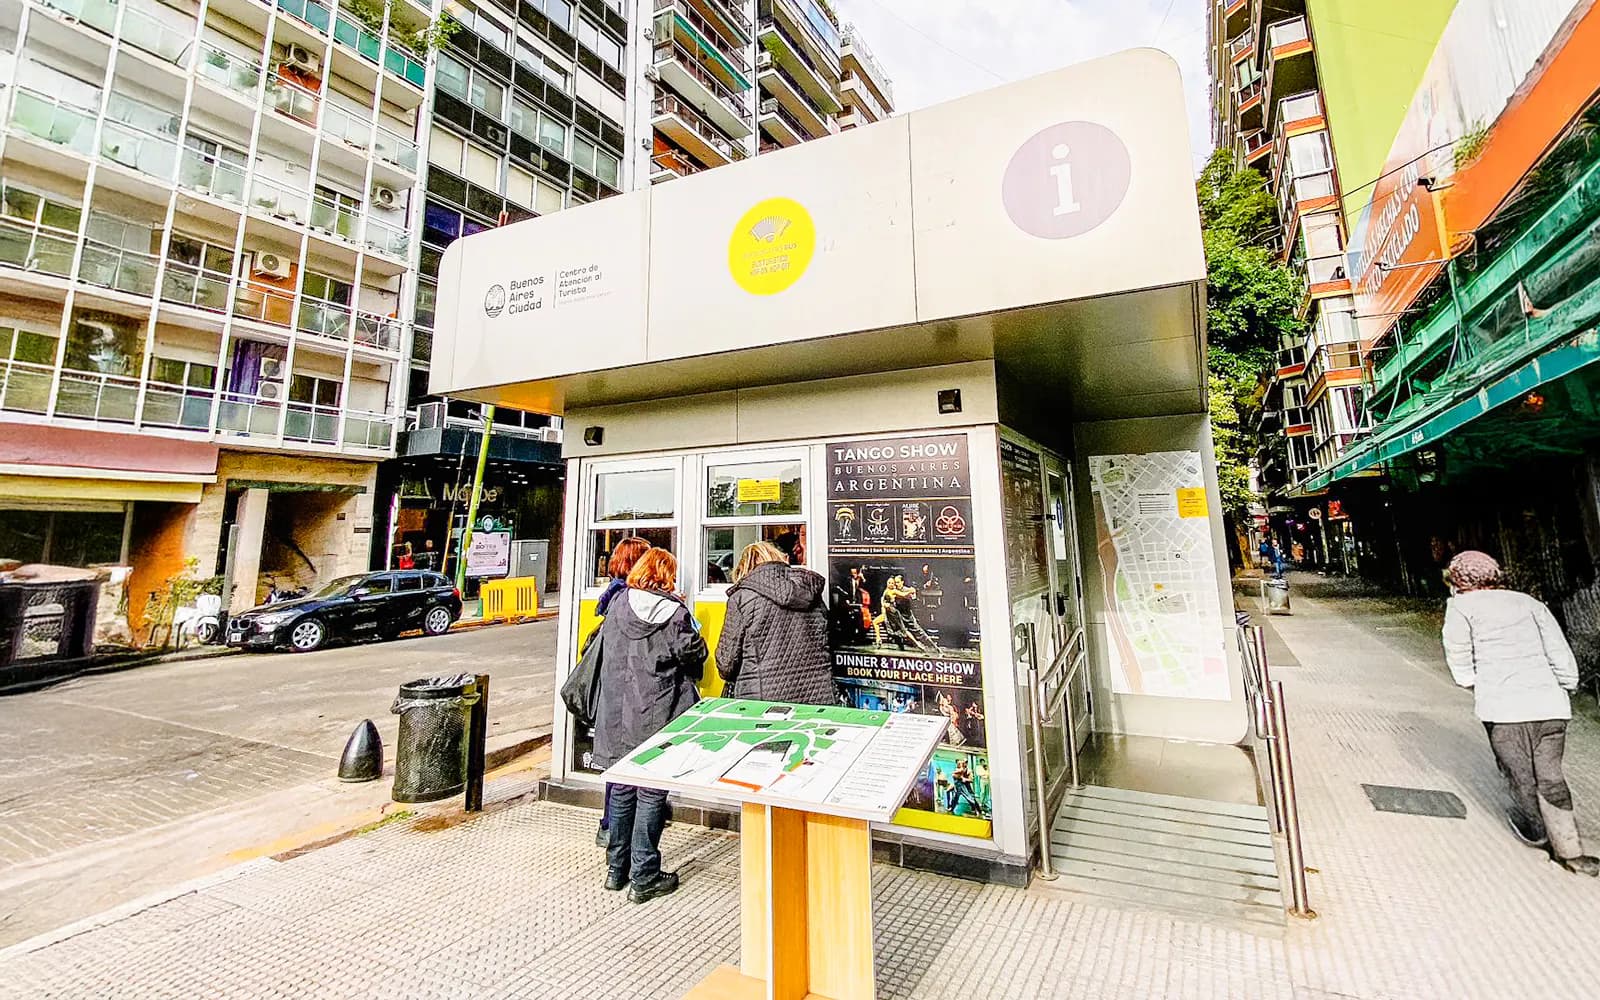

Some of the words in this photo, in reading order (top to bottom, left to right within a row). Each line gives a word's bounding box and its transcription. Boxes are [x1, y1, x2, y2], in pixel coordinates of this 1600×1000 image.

[560, 267, 587, 278] Centro
[589, 264, 598, 272] de
[595, 271, 602, 280] al
[510, 276, 544, 290] Buenos
[509, 290, 534, 302] Aires
[560, 286, 587, 297] Turista
[509, 297, 542, 314] Ciudad
[834, 446, 894, 461] TANGO
[900, 442, 958, 458] SHOW
[834, 464, 897, 475] BUENOS
[908, 461, 960, 472] AIRES
[834, 476, 961, 492] ARGENTINA
[836, 654, 878, 669] DINNER
[880, 657, 889, 669] &
[891, 657, 933, 672] TANGO
[935, 661, 975, 675] SHOW
[847, 667, 873, 677] BOOK
[873, 668, 901, 680] YOUR
[902, 670, 934, 682] PLACE
[935, 674, 963, 685] HERE
